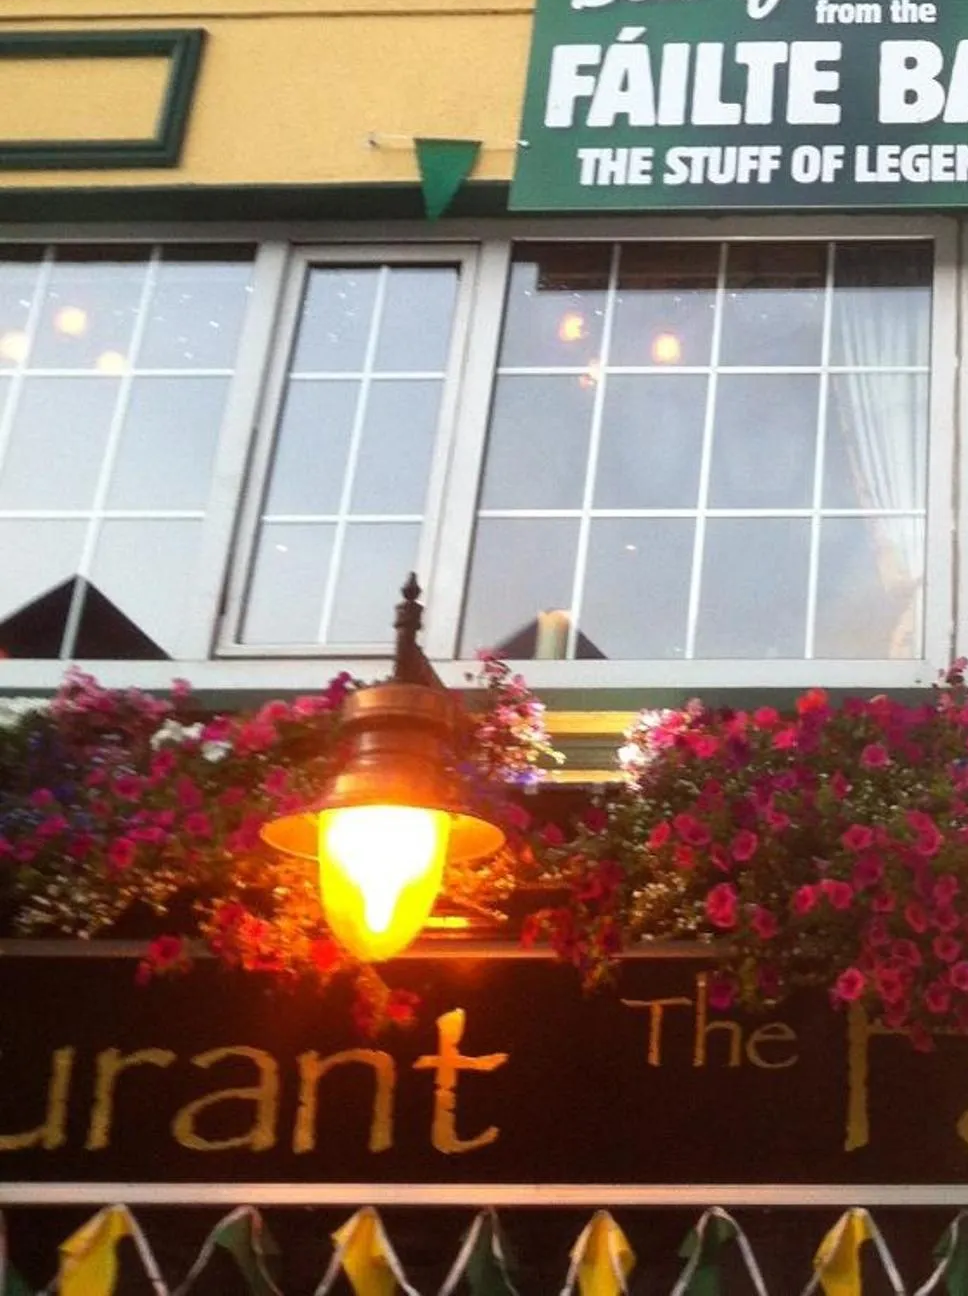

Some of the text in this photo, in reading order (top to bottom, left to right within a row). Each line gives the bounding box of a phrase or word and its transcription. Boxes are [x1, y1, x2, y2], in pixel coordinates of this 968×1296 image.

[544, 26, 842, 128] FÁILTE
[577, 147, 653, 186] THE
[663, 145, 782, 185] STUFF
[791, 145, 844, 184] OF
[624, 972, 799, 1069] The
